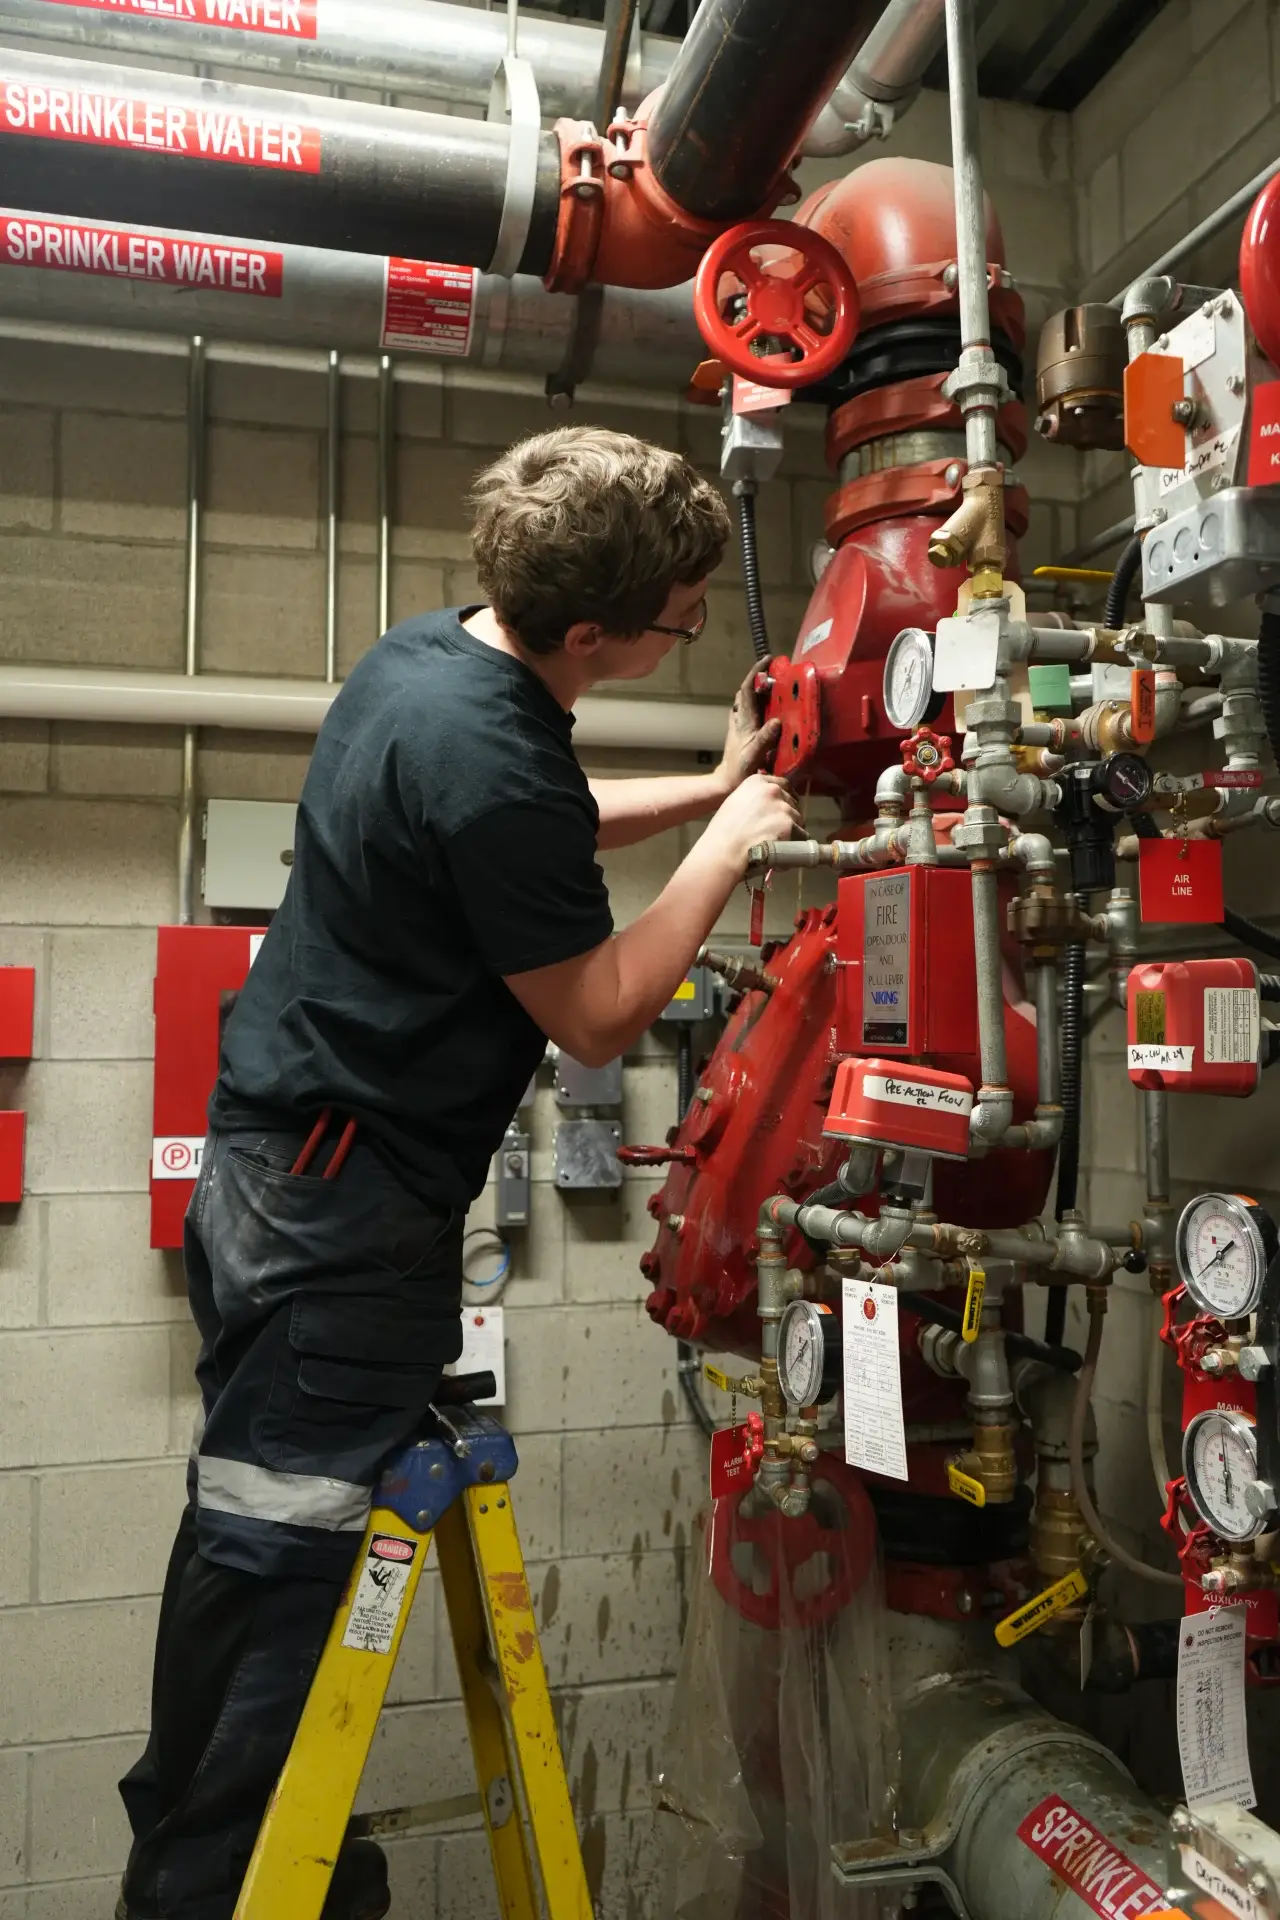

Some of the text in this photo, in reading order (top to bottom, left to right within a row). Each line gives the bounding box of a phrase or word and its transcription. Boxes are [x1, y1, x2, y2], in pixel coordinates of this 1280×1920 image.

[5, 84, 302, 165] SPRINKLER WATER
[6, 221, 267, 292] SPRINKLER WATER
[1173, 874, 1190, 884] AIR
[1171, 886, 1193, 896] LINE
[876, 904, 898, 926] FIRE
[866, 932, 907, 947] OPEN DOOR
[879, 954, 894, 966] AND
[885, 973, 904, 985] LEVER
[871, 991, 899, 1005] VIKING
[938, 1089, 964, 1107] FLOW
[1216, 1402, 1243, 1412] MAIN
[723, 1456, 743, 1469] ALARM
[726, 1466, 740, 1478] TEST
[376, 1542, 409, 1557] DANGER
[1202, 1593, 1259, 1609] AUXILIARY
[1198, 1623, 1234, 1637] DO NOT REMOVE
[1197, 1631, 1242, 1648] INSPECTION RECORD
